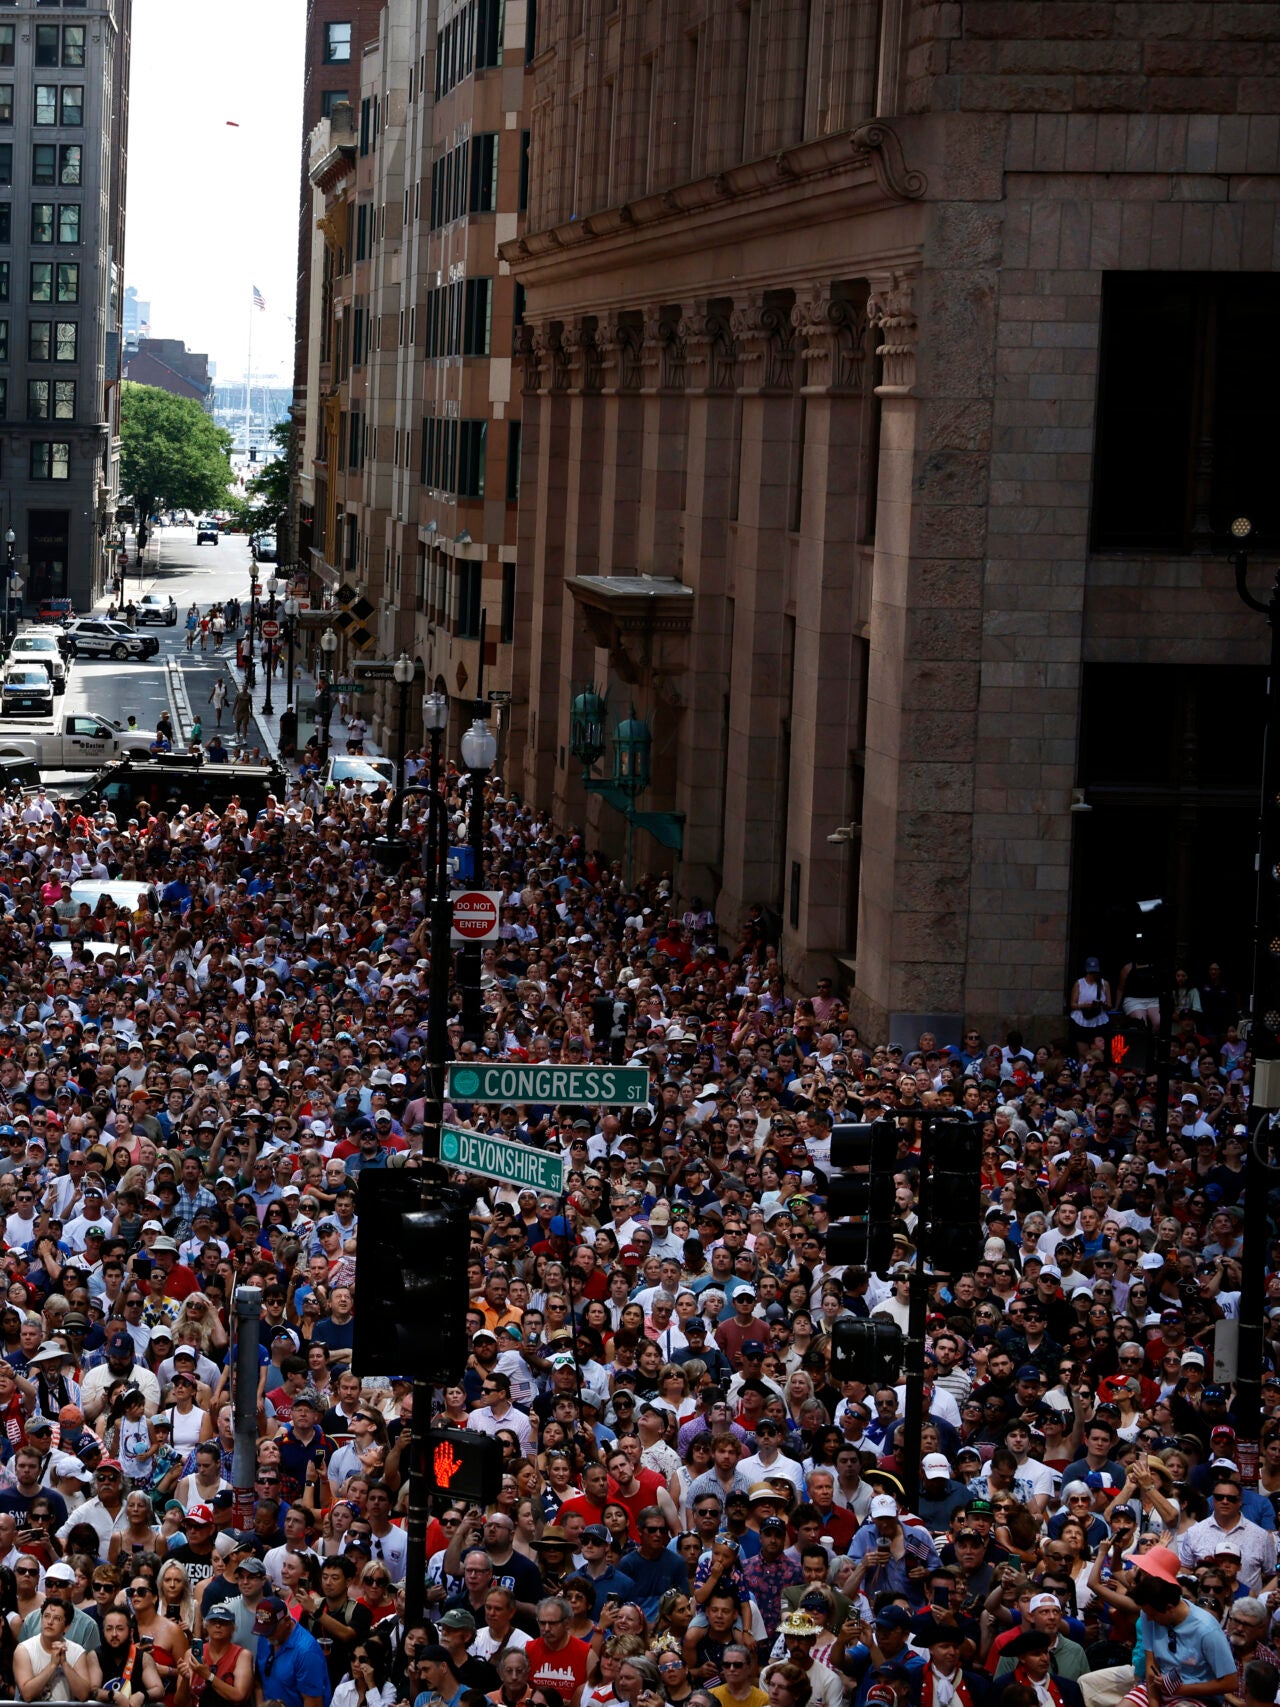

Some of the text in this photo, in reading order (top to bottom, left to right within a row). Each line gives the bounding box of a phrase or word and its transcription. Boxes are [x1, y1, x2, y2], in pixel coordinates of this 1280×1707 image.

[484, 1069, 642, 1100] CONGRESS ST
[459, 1135, 560, 1190] DEVONSHIRE ST
[533, 1679, 557, 1687] BOSTON
